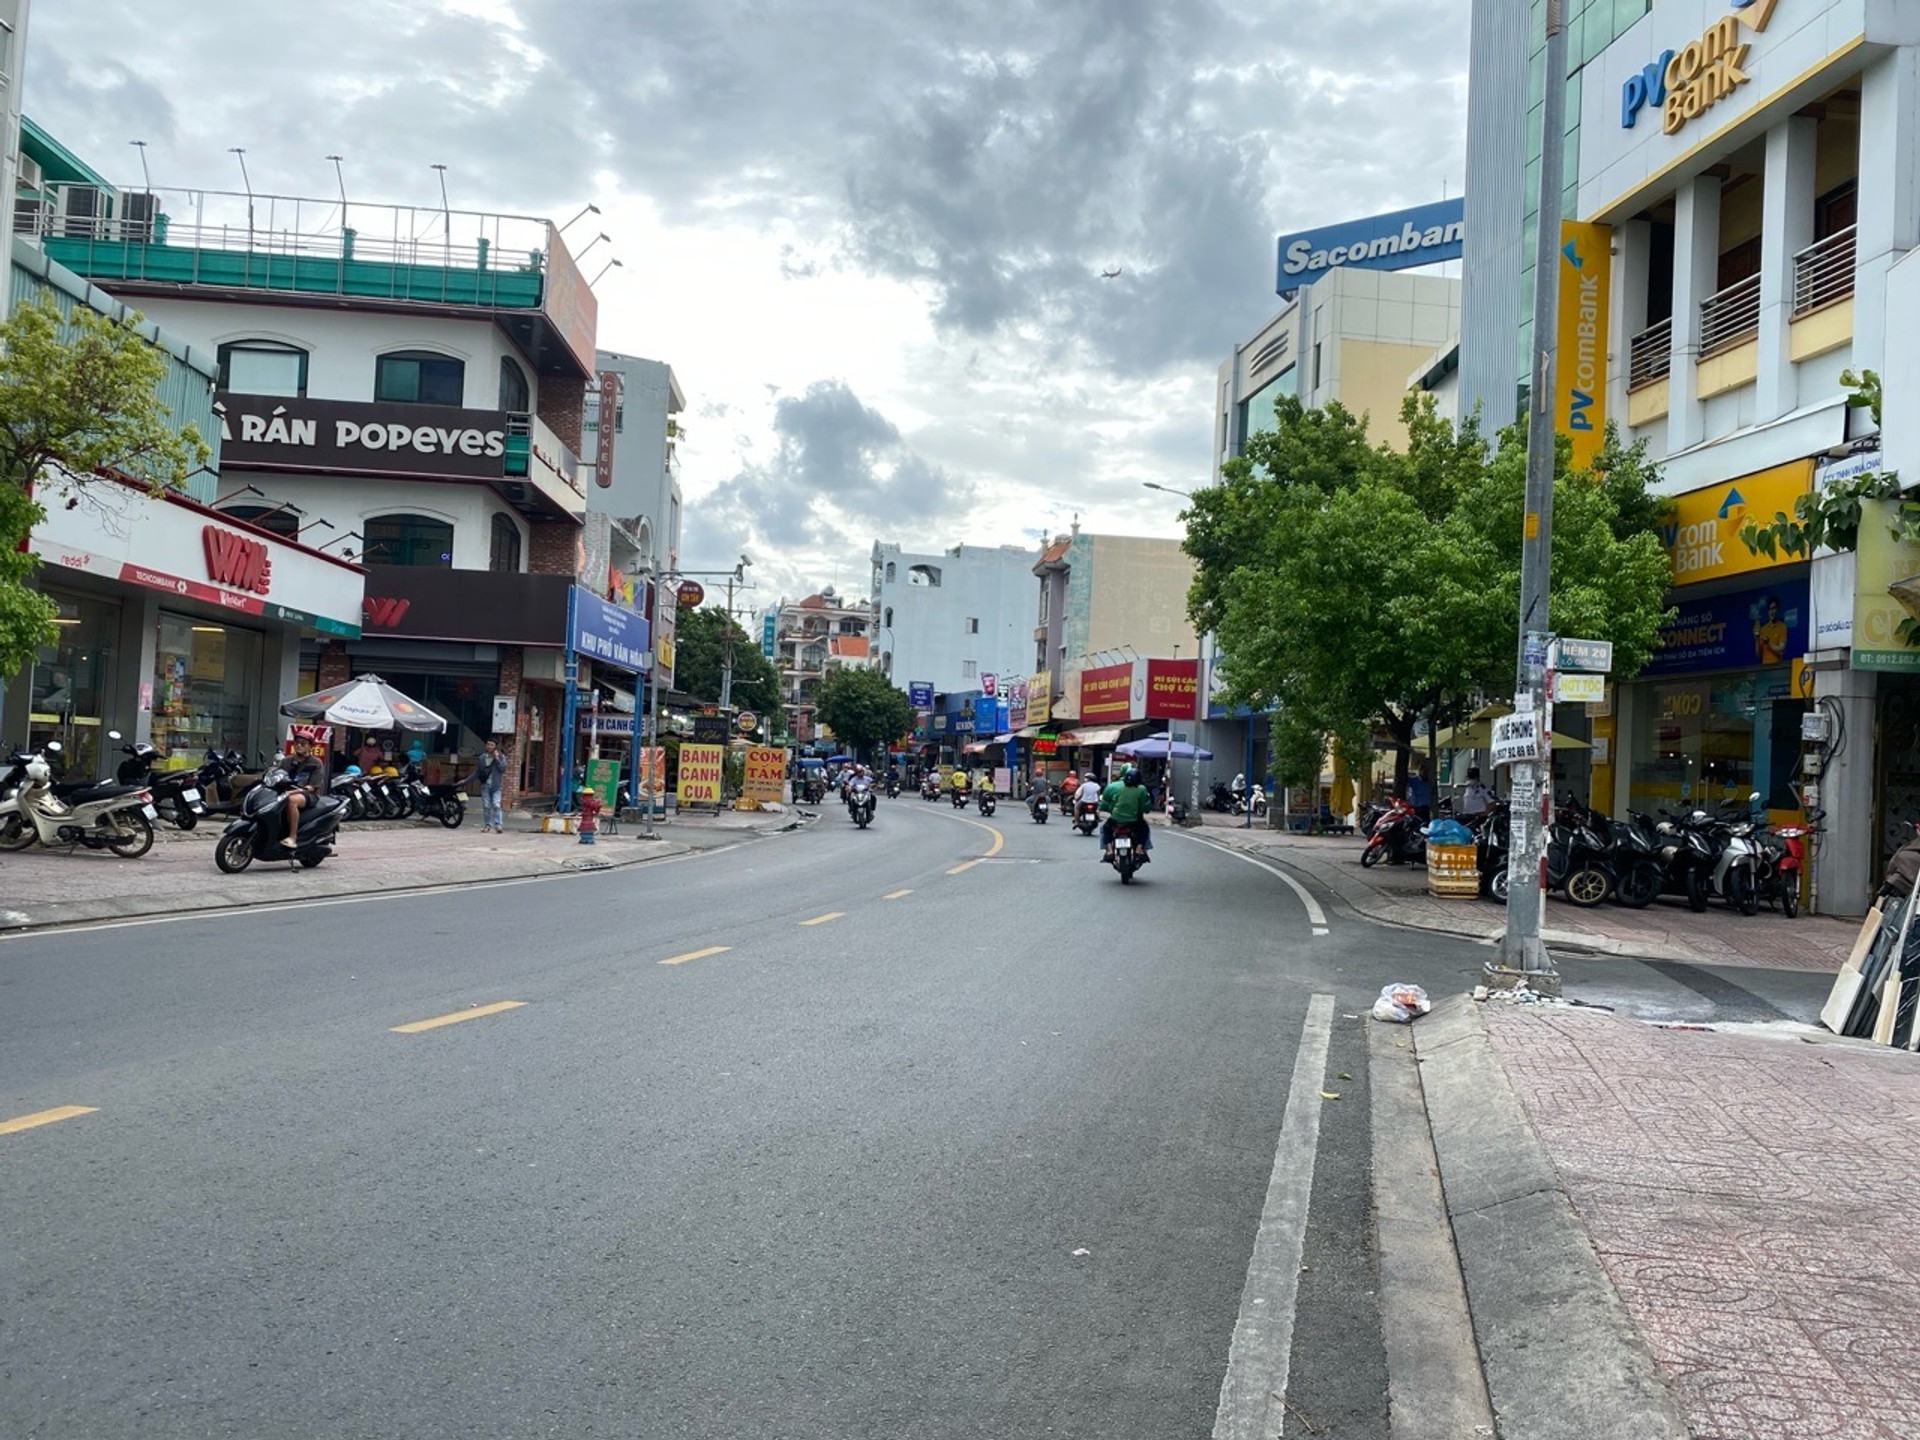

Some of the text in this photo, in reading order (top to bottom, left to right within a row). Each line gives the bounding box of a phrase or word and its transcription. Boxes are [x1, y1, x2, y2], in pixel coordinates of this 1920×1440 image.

[1663, 43, 1751, 135] Bank
[241, 405, 317, 446] RÁN
[600, 381, 613, 475] CHICKEN
[1676, 541, 1725, 574] Bank
[581, 630, 597, 652] KHU
[597, 636, 613, 658] PHỐ
[1592, 648, 1606, 658] 20
[749, 749, 783, 763] CƠM
[680, 767, 720, 781] CANH
[747, 763, 782, 779] TẤM
[684, 785, 713, 798] CUA
